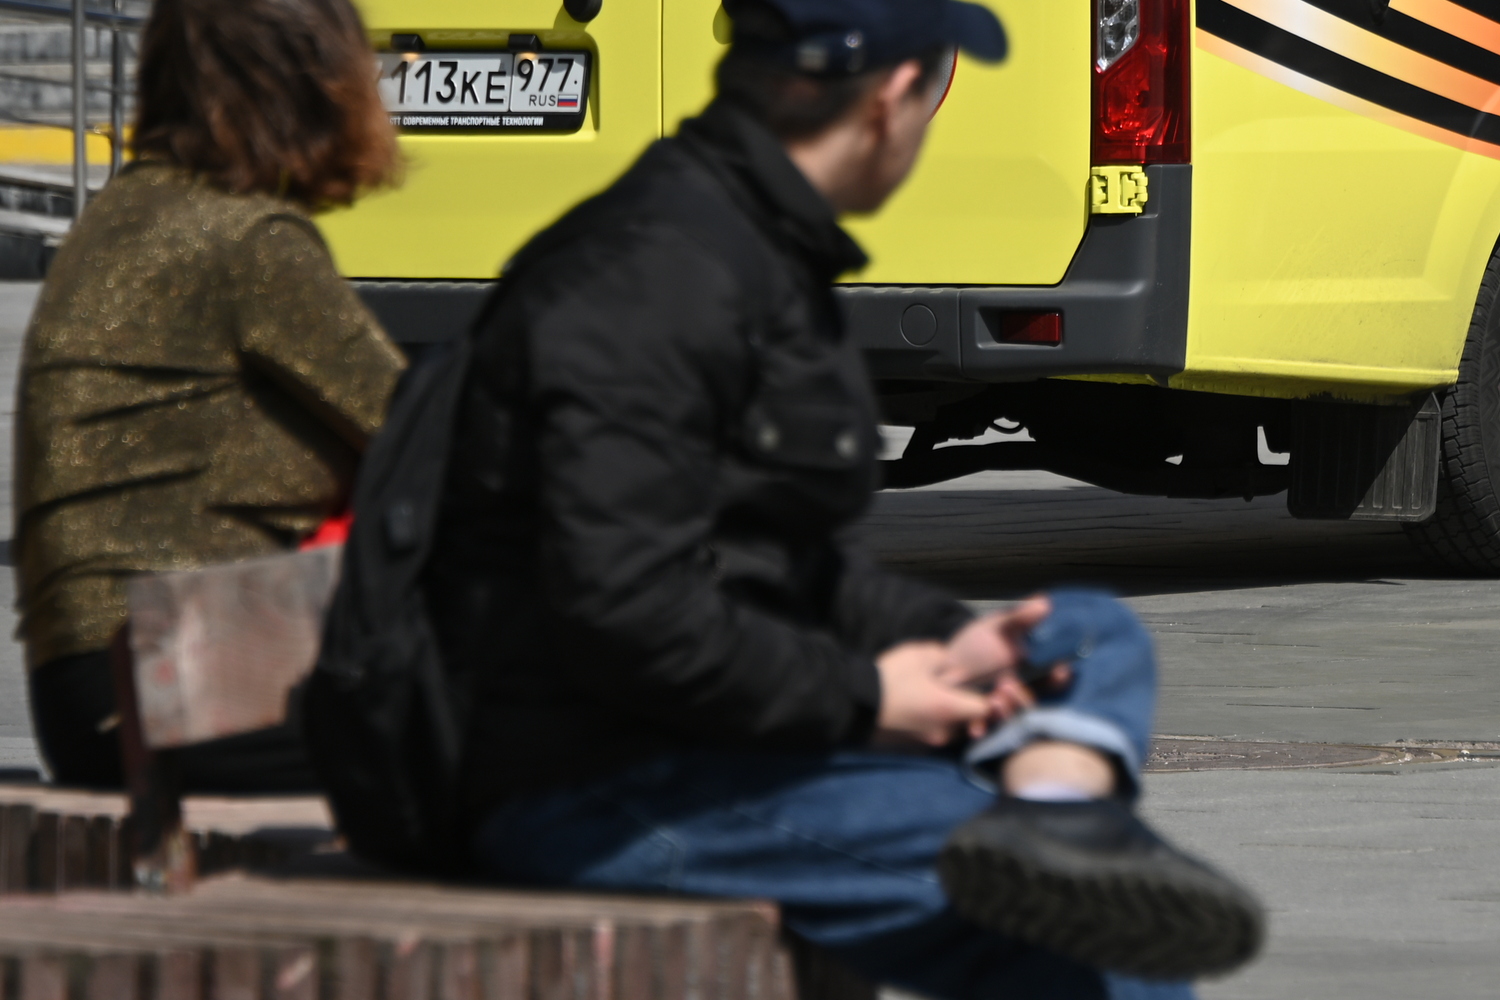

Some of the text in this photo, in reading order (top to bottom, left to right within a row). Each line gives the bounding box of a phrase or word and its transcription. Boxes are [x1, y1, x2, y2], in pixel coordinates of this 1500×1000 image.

[517, 58, 575, 92] 977
[529, 94, 556, 107] RUS
[402, 115, 449, 126] СОВРЕМЕННЫЕ
[450, 115, 500, 126] ТРАНСПОРТНЫЕ
[502, 116, 544, 126] ТЕХНОЛОГИИ
